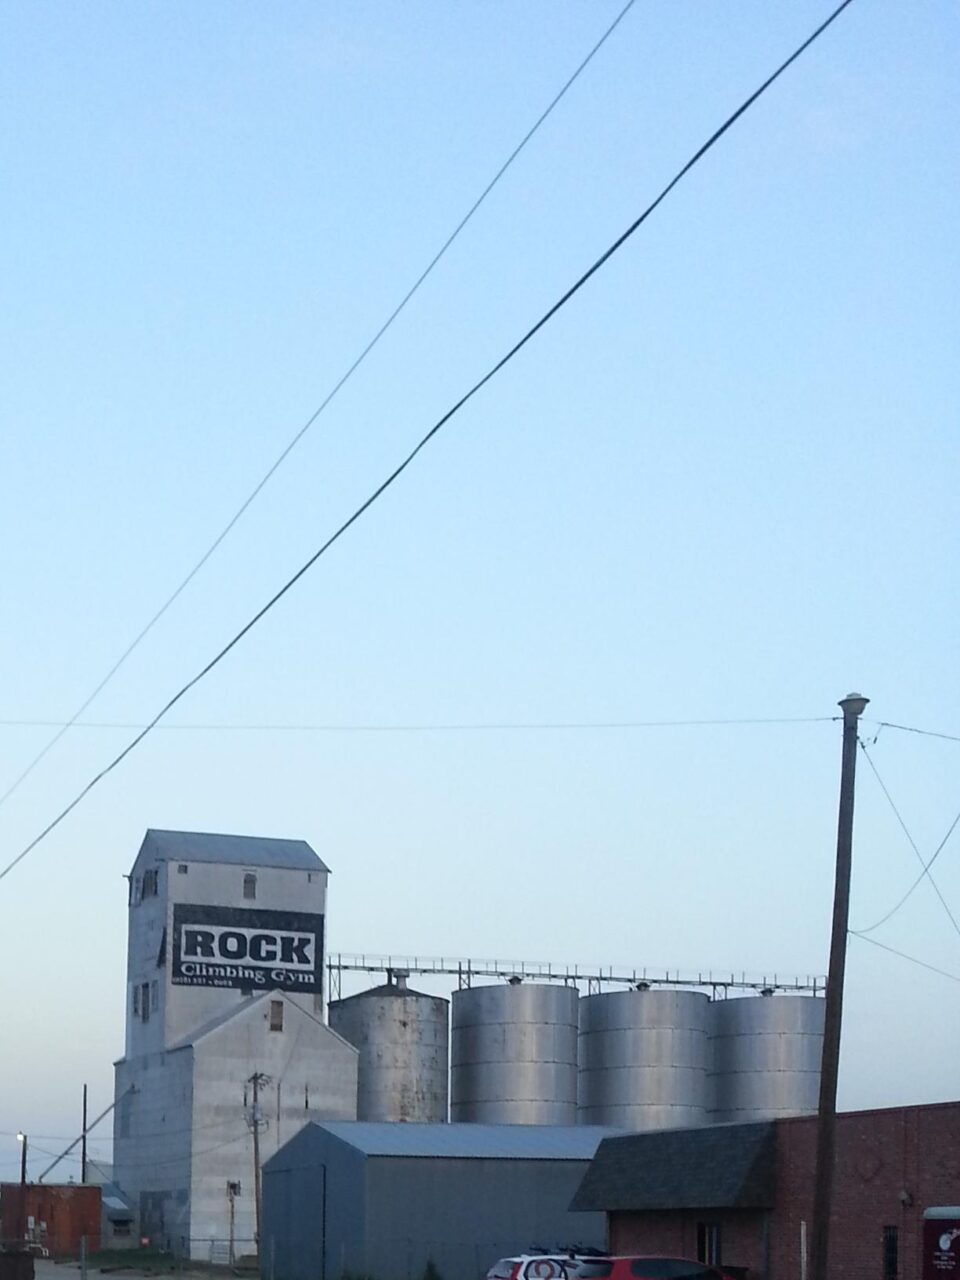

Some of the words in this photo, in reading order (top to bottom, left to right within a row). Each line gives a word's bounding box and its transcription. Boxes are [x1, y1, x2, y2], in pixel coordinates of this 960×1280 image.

[184, 930, 311, 964] ROCK
[181, 963, 266, 984] Climbing
[271, 969, 315, 985] Gym
